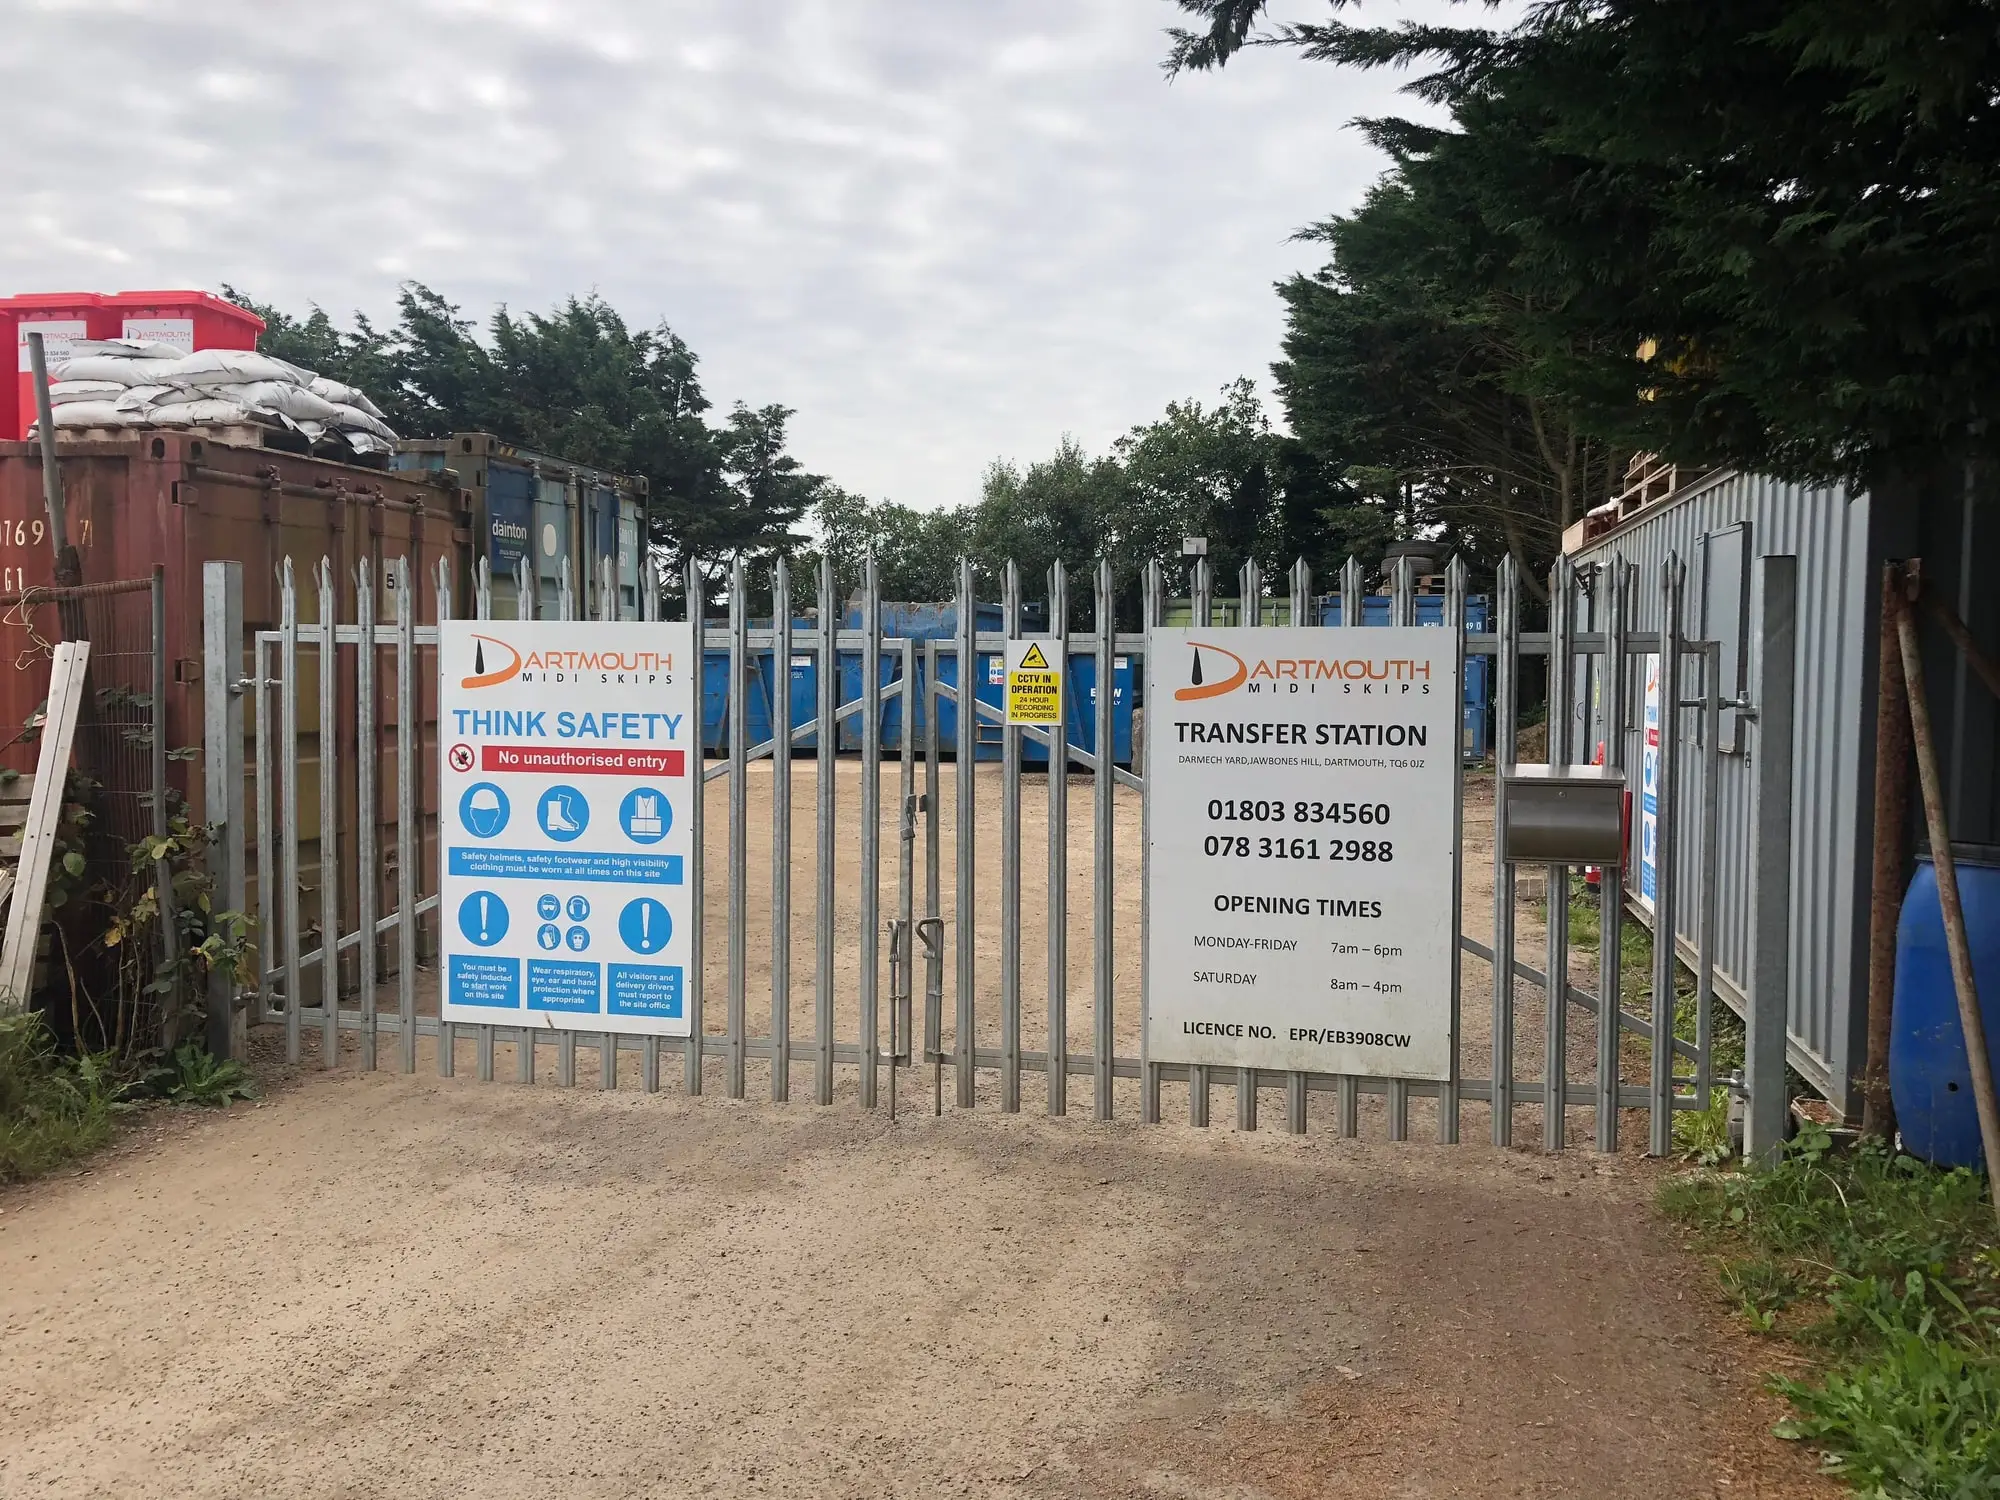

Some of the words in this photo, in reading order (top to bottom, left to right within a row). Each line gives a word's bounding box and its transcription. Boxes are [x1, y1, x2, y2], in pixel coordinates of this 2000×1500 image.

[0, 520, 44, 546] 769
[492, 519, 527, 540] dainton
[386, 573, 395, 589] 5
[461, 634, 672, 689] DARTMOUTH
[1174, 641, 1430, 701] DARTMOUTH
[522, 672, 578, 683] MIDI
[600, 673, 672, 684] SKIPS
[1017, 674, 1040, 683] CCTV
[1042, 674, 1052, 683] IN
[1011, 685, 1057, 694] OPERATION
[1248, 683, 1315, 694] MIDI
[1343, 683, 1430, 694] SKIPS
[452, 709, 547, 737] THINK
[556, 711, 683, 740] SAFETY
[1174, 722, 1307, 745] TRANSFER
[1315, 724, 1427, 747] STATION
[498, 751, 518, 764] No
[523, 752, 624, 767] unauthorised
[629, 754, 668, 771] entry
[1178, 755, 1223, 764] DARMECH
[1300, 758, 1321, 767] HILL,
[1324, 758, 1387, 768] DARTMOUTH,
[1389, 759, 1408, 768] TQ6
[1410, 759, 1425, 768] 0JZ
[1207, 799, 1285, 822] 01803
[1293, 801, 1390, 825] 834560
[1203, 835, 1250, 857] 078
[1258, 837, 1321, 860] 3161
[1329, 839, 1393, 862] 2988
[461, 852, 488, 862] Safety
[489, 853, 525, 863] helmets,
[526, 854, 552, 865] safety
[554, 855, 591, 865] footwear
[593, 857, 610, 866] and
[611, 858, 631, 867] high
[633, 859, 669, 869] visibility
[470, 863, 504, 873] clothing
[505, 864, 527, 872] must
[528, 864, 539, 873] be
[541, 866, 562, 874] worn
[574, 867, 585, 875] all
[587, 868, 610, 876] times
[626, 868, 642, 877] this
[644, 869, 661, 878] site
[1213, 894, 1310, 915] OPENING
[1316, 898, 1382, 918] TIMES
[1194, 935, 1298, 951] MONDAY-FRIDAY
[1330, 942, 1359, 955] 7am
[1373, 944, 1402, 958] 6pm
[462, 962, 476, 970] You
[477, 964, 496, 972] must
[497, 964, 507, 972] be
[532, 966, 551, 975] Wear
[553, 969, 596, 978] respiratory,
[456, 972, 479, 981] safety
[480, 973, 513, 982] inducted
[531, 977, 547, 985] eye,
[616, 971, 627, 979] All
[628, 972, 657, 980] visitors
[461, 981, 470, 989] to
[471, 982, 488, 990] start
[489, 983, 507, 991] work
[615, 981, 646, 991] delivery
[647, 983, 675, 991] drivers
[1193, 971, 1257, 985] SATURDAY
[1330, 978, 1358, 991] 8am
[1372, 980, 1402, 994] 4pm
[475, 991, 490, 999] this
[491, 992, 505, 1000] site
[532, 985, 571, 994] protection
[572, 988, 595, 996] where
[618, 991, 637, 999] must
[542, 996, 585, 1004] appropriate
[633, 1001, 647, 1009] site
[1183, 1021, 1244, 1037] LICENCE
[1248, 1025, 1277, 1040] NO.
[1289, 1027, 1411, 1048] EPR/EB3908CW
